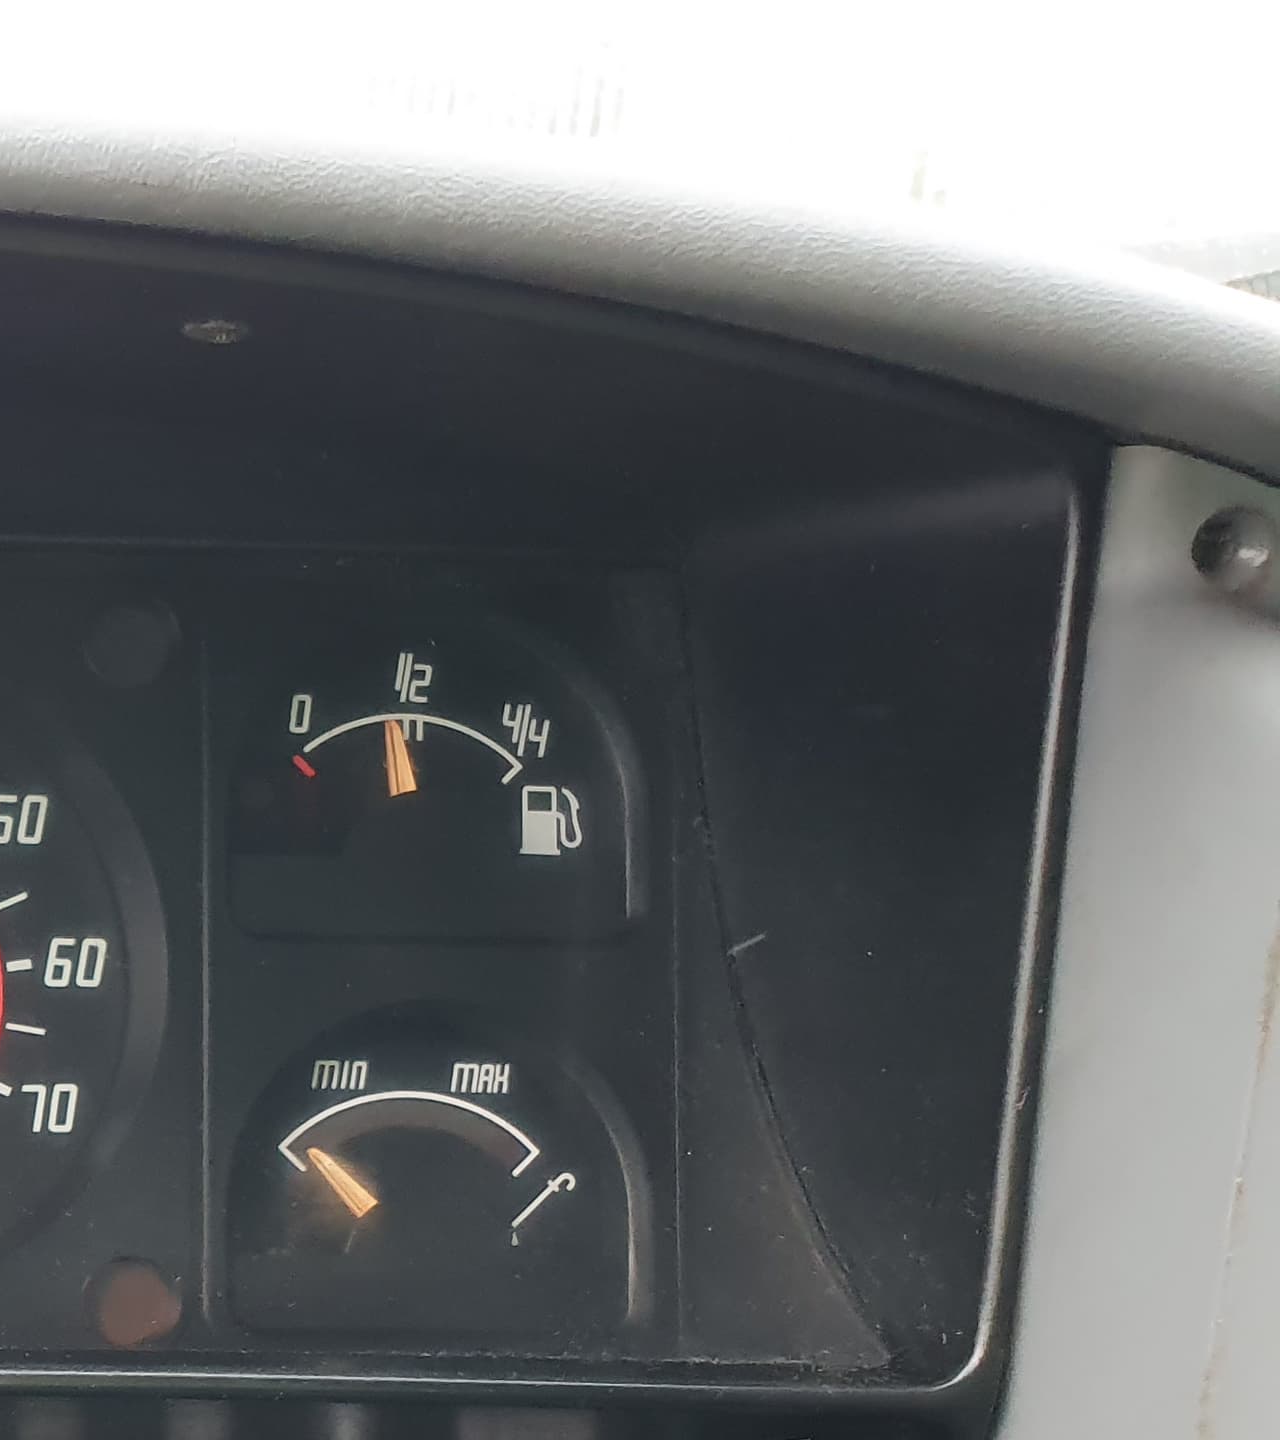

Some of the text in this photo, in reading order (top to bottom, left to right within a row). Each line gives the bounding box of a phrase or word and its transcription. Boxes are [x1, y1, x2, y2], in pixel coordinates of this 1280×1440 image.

[288, 694, 313, 734] 0
[502, 703, 551, 758] 4/4
[42, 937, 108, 988] 60
[311, 1059, 369, 1091] MIN
[449, 1062, 511, 1095] MAX
[21, 1084, 79, 1134] 70
